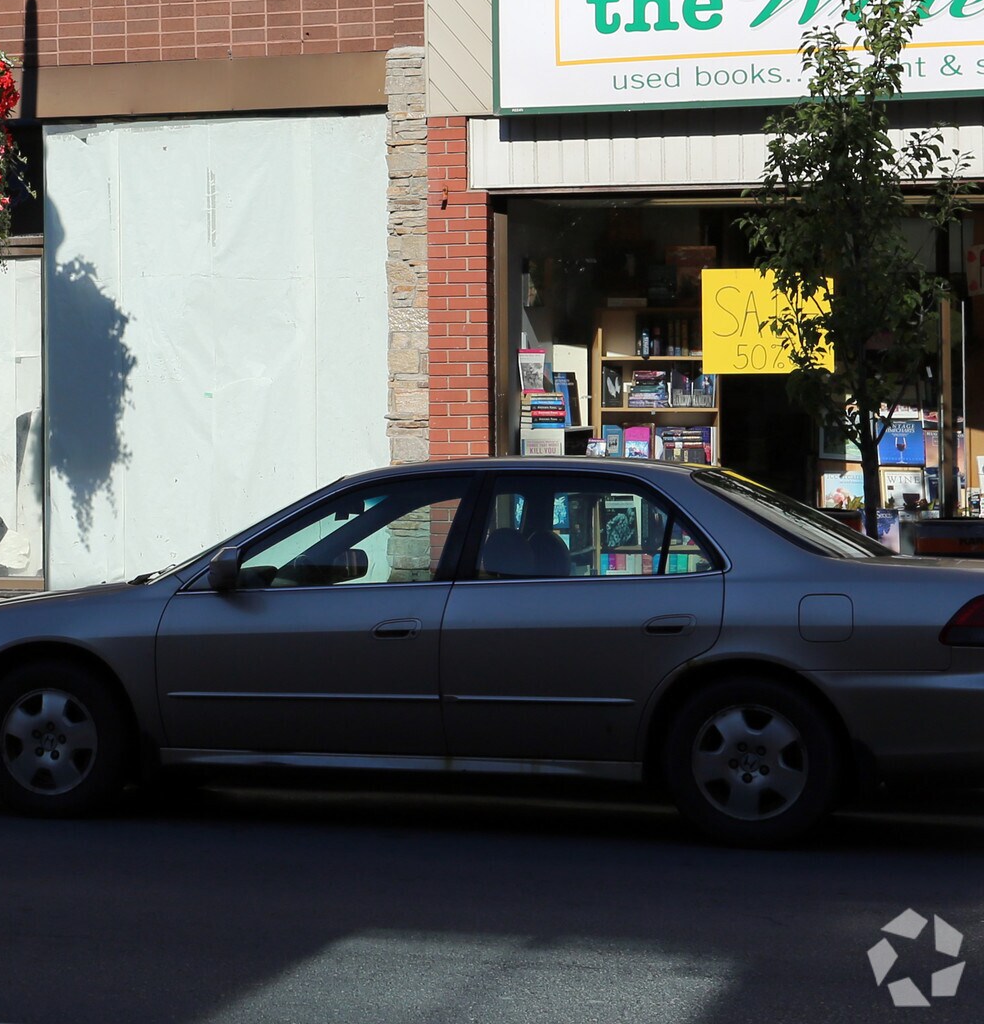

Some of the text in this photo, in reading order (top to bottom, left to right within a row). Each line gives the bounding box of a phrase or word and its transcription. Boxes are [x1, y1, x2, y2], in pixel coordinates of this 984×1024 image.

[612, 66, 681, 91] used
[939, 54, 963, 77] &
[732, 343, 785, 371] 50%
[887, 475, 921, 484] WINE
